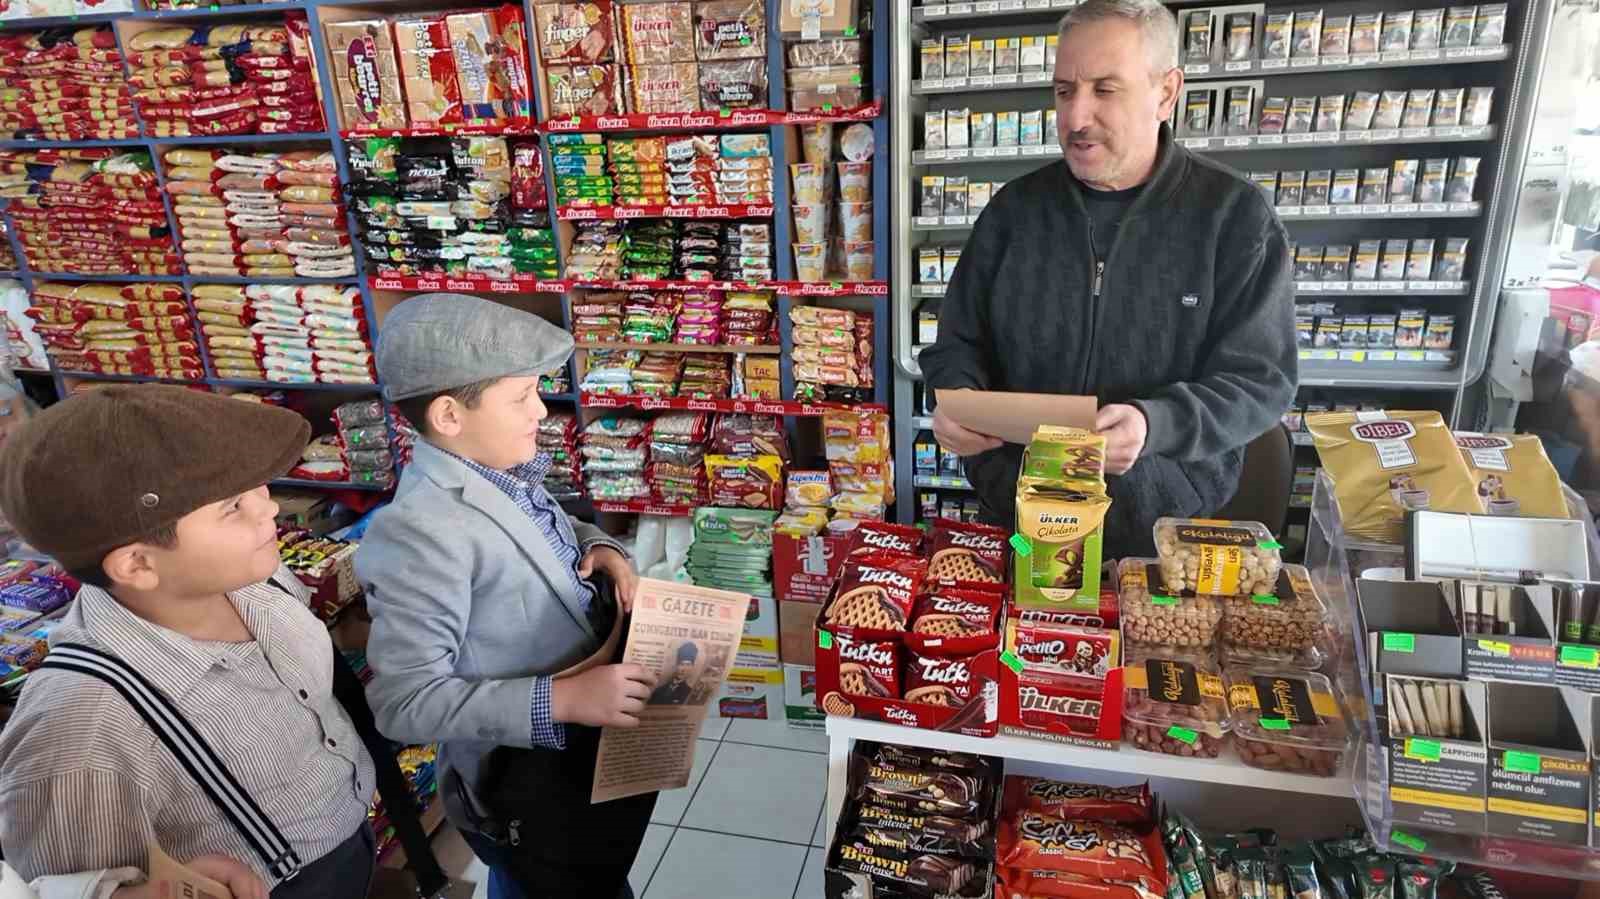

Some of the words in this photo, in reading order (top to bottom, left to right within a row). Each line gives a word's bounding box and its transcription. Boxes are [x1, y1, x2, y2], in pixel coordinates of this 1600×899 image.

[634, 16, 672, 31] ÜLKER
[544, 24, 589, 44] finger
[554, 82, 594, 102] finger
[597, 118, 629, 128] ÜLKER
[648, 116, 680, 128] ÜLKER
[681, 113, 714, 126] ÜLKER
[614, 208, 645, 218] ÜLKER
[697, 206, 728, 216] ÜLKER
[754, 403, 784, 413] ÜLKER
[1040, 513, 1078, 524] ÜLKER
[948, 531, 1001, 549] Tutku
[857, 566, 913, 589] Tutku
[887, 587, 912, 598] TART
[662, 598, 715, 617] GAZETE
[931, 596, 990, 613] Tutku
[838, 637, 894, 665] Tutku
[869, 665, 894, 676] TART
[918, 656, 970, 682] Tutk
[1020, 687, 1101, 718] ÜLKER
[884, 706, 918, 721] Tutku
[1004, 727, 1030, 736] ÜLKER
[1491, 780, 1523, 791] neden
[1524, 784, 1547, 796] olur.
[1532, 775, 1581, 788] amfizeme
[841, 844, 909, 876] Browni
